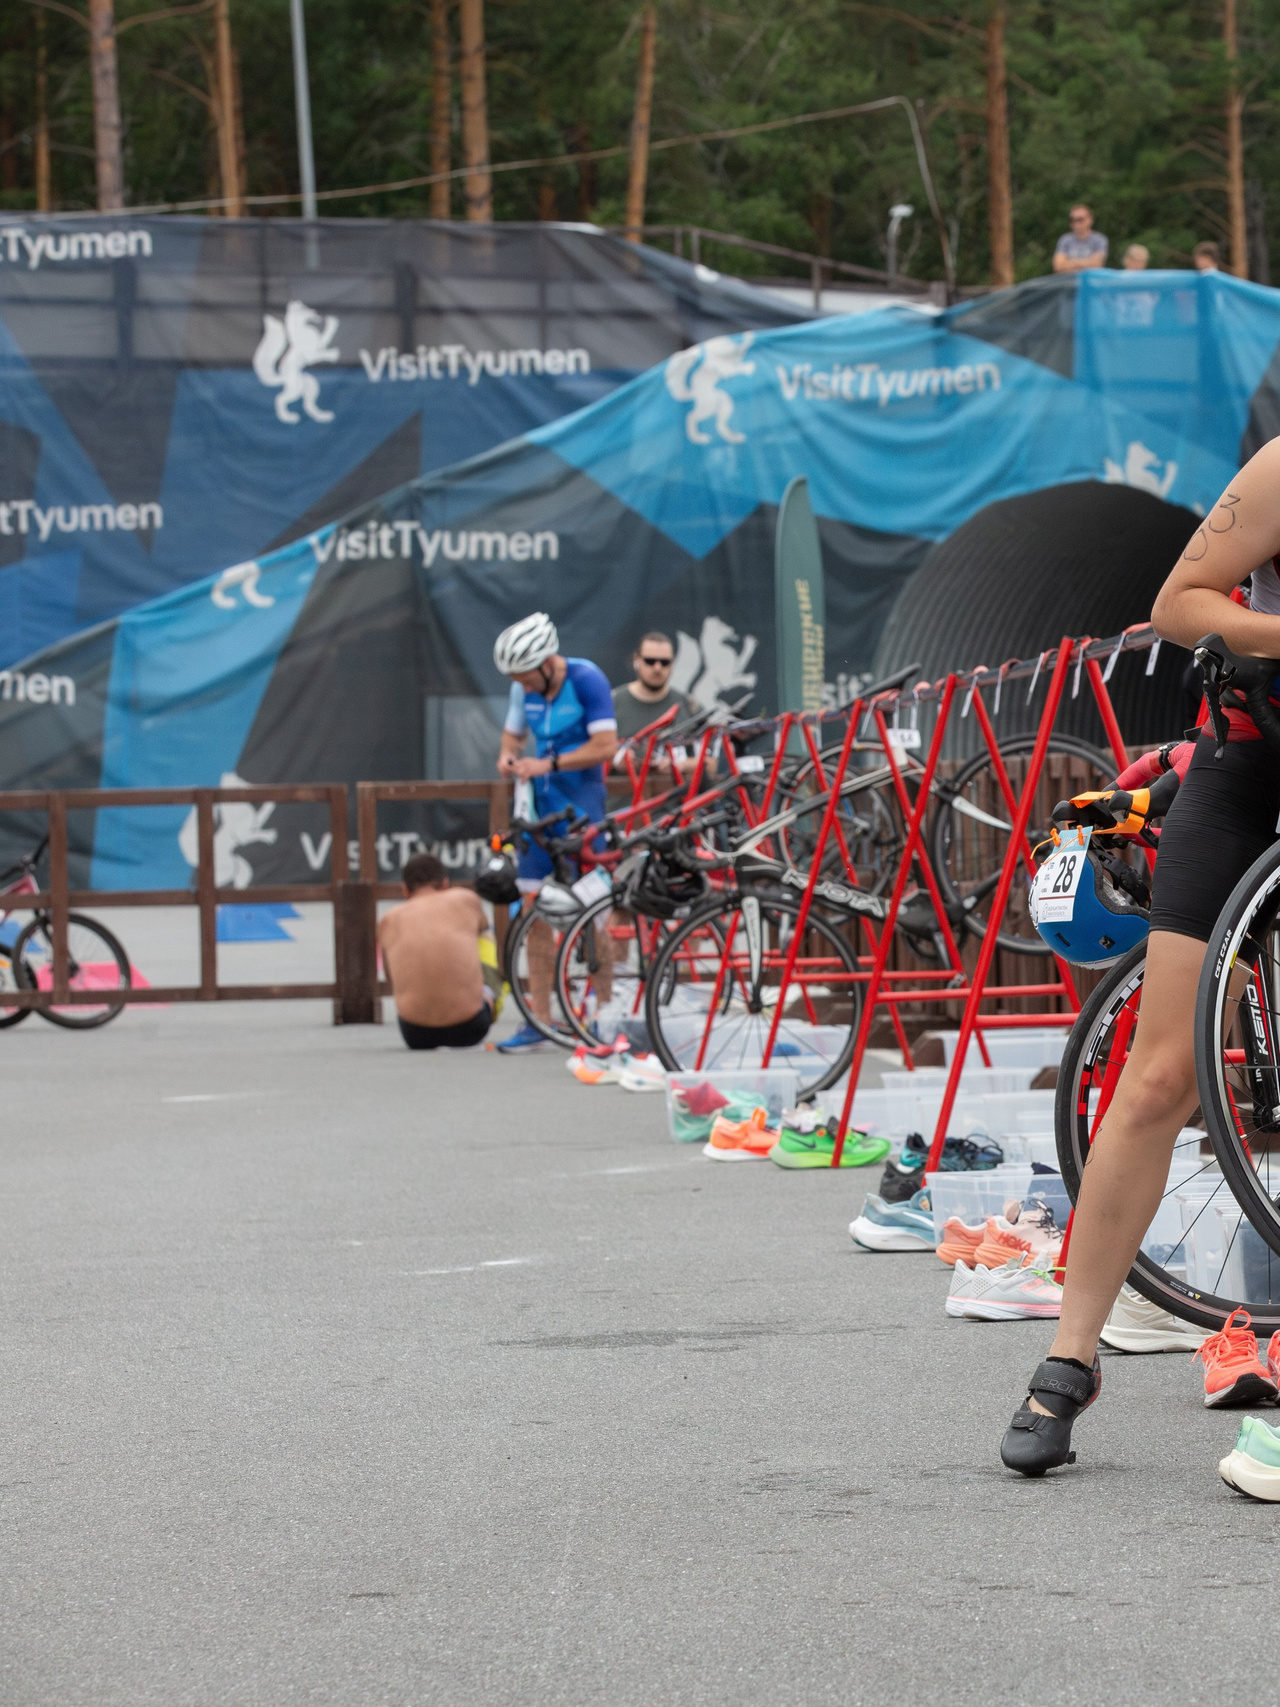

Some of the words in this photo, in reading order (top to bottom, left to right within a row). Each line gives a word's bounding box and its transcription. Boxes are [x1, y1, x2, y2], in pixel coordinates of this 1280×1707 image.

[358, 343, 590, 386] VisitTyumen
[776, 358, 1001, 409] VisitTyumen
[309, 520, 559, 567] VisitTyumen
[1052, 855, 1077, 893] 28
[1214, 955, 1226, 980] CST
[998, 1231, 1032, 1253] HOKA
